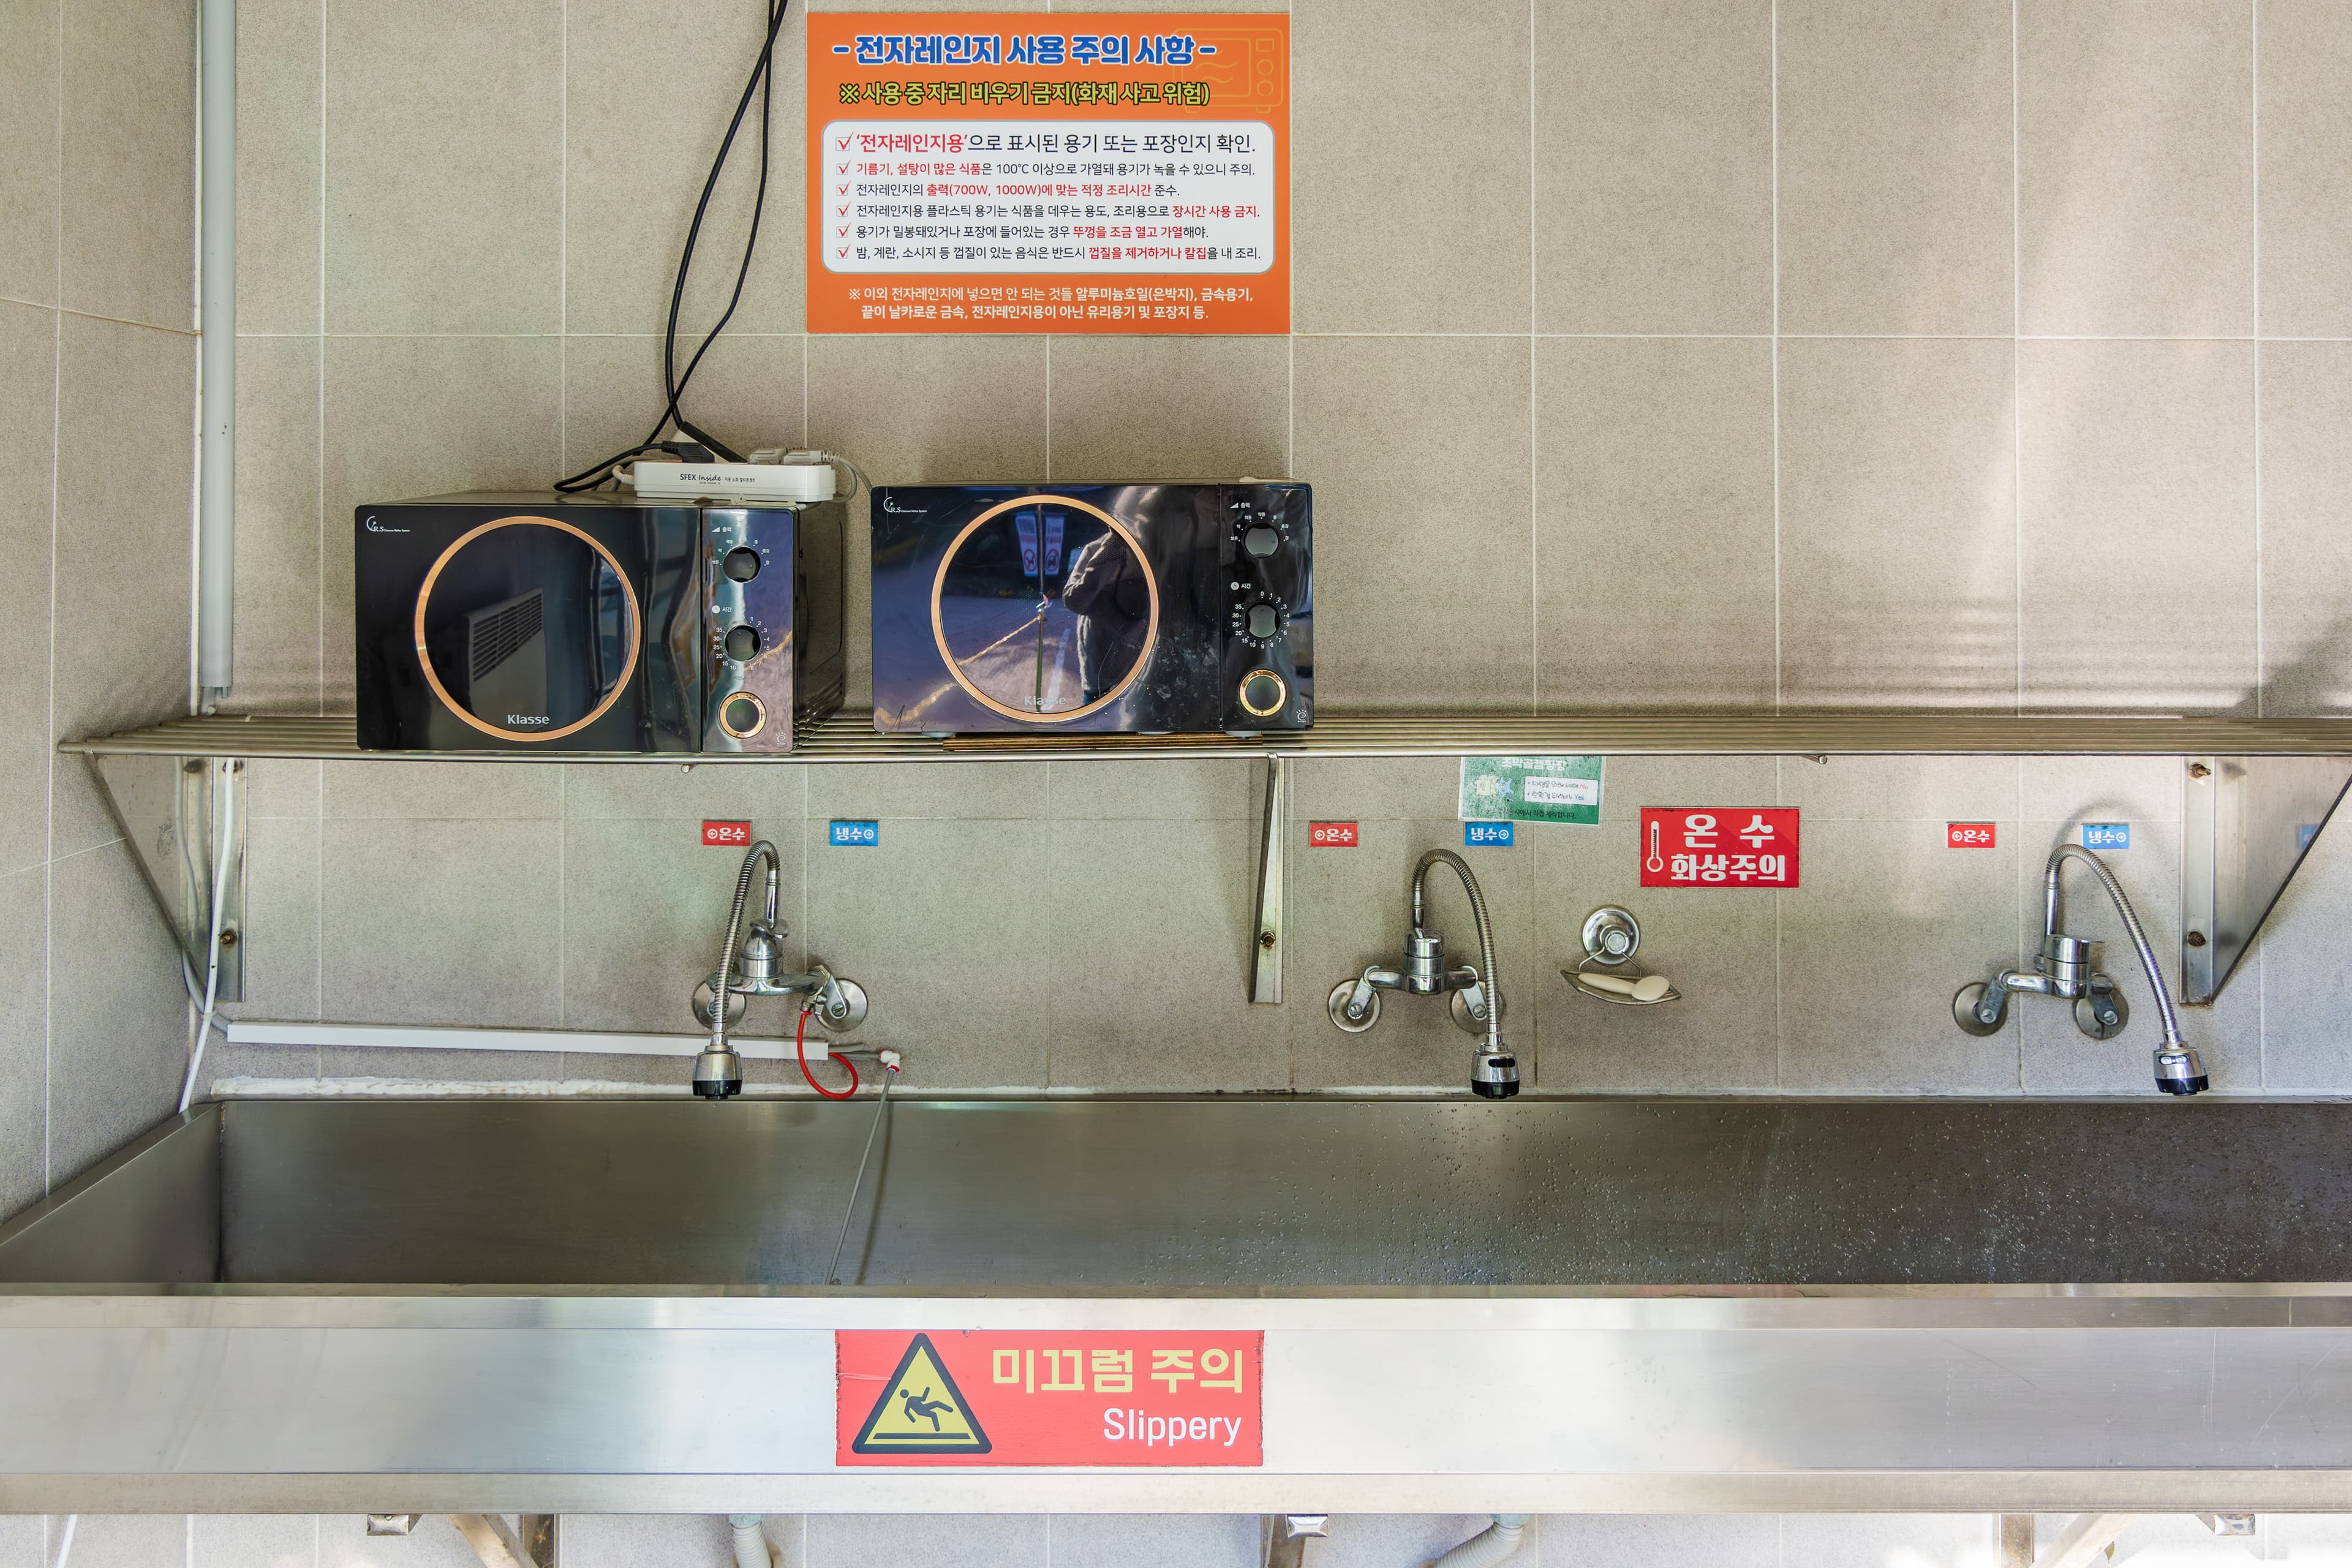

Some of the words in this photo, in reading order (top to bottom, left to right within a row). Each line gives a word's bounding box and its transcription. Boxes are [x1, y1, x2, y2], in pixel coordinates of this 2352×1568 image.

[855, 34, 1001, 65] 전자레인지
[1005, 34, 1066, 65] 사용
[1070, 35, 1129, 65] 주의
[1134, 35, 1196, 66] 사항
[861, 81, 903, 106] 사용
[904, 81, 925, 106] 중
[925, 81, 968, 105] 자리
[969, 81, 1030, 105] 비우기
[1030, 81, 1118, 107] 금지(화재
[1119, 81, 1161, 106] 사고
[1161, 81, 1211, 107] 위험)
[1006, 134, 1058, 153] 표시된
[1063, 134, 1097, 154] 용기
[1102, 134, 1138, 153] 또는
[1142, 134, 1211, 154] 포장인지
[1216, 134, 1256, 154] 확인.
[857, 162, 893, 176] 기름기,
[897, 162, 930, 176] 설탕이
[933, 162, 956, 176] 많은
[959, 162, 993, 176] 식품은
[1032, 162, 1078, 176] 이상으로
[1080, 162, 1114, 176] 가열돼
[1117, 163, 1151, 176] 용기가
[1153, 163, 1177, 176] 녹을
[1178, 163, 1191, 176] 수
[1193, 163, 1226, 176] 있으니
[1229, 163, 1255, 176] 주의.
[856, 183, 923, 197] 전자레인지의
[926, 183, 991, 197] 출력(700W,
[995, 184, 1053, 197] 1000W)에
[1055, 184, 1079, 197] 맞는
[1081, 184, 1103, 197] 적정
[1106, 184, 1152, 197] 조리시간
[1154, 184, 1180, 197] 준수.
[856, 204, 924, 218] 전자레인지용
[926, 204, 971, 217] 플라스틱
[974, 204, 1009, 218] 용기는
[1011, 204, 1045, 218] 식품을
[1047, 204, 1082, 218] 데우는
[1084, 205, 1110, 218] 용도,
[1113, 205, 1170, 218] 조리용으로
[1172, 205, 1207, 218] 장시간
[1208, 205, 1232, 219] 사용
[1234, 205, 1260, 218] 금지.
[856, 225, 891, 239] 용기가
[893, 225, 961, 239] 밀봉돼있거나
[962, 225, 997, 239] 포장에
[999, 225, 1046, 239] 들어있는
[1048, 225, 1071, 239] 경우
[1072, 225, 1107, 239] 뚜껑을
[1109, 226, 1133, 239] 조금
[1135, 225, 1158, 239] 열고
[1161, 225, 1208, 239] 가열해야.
[856, 246, 870, 260] 밤,
[873, 246, 899, 260] 계란,
[902, 246, 936, 260] 소시지
[938, 246, 951, 260] 등
[953, 246, 986, 260] 껍질이
[990, 246, 1012, 260] 있는
[1015, 246, 1049, 260] 음식은
[1052, 246, 1085, 260] 반드시
[1088, 246, 1123, 260] 껍질을
[1125, 246, 1182, 260] 제거하거나
[1184, 247, 1219, 260] 칼집을
[1221, 246, 1232, 260] 내
[1235, 246, 1261, 260] 조리.
[864, 287, 888, 301] 이외
[891, 287, 963, 301] 전자레인지에
[967, 287, 1003, 301] 넣으면
[1006, 287, 1019, 301] 안
[1021, 287, 1046, 301] 되는
[1049, 287, 1073, 301] 것들
[1076, 287, 1197, 302] 알루미늄호일(은박지),
[1200, 287, 1253, 302] 금속용기,
[861, 304, 886, 319] 끝이
[889, 304, 938, 319] 날카로운
[940, 305, 968, 319] 금속,
[972, 304, 1056, 319] 전자레인지용이
[1059, 305, 1084, 319] 아닌
[1087, 305, 1135, 320] 유리용기
[1139, 305, 1150, 319] 및
[1153, 305, 1189, 320] 포장지
[1193, 306, 1208, 320] 등.
[507, 714, 549, 725] Klasse
[718, 827, 745, 840] 온수
[835, 827, 863, 840] 냉수
[1326, 828, 1353, 842] 온수
[1471, 827, 1498, 841] 냉수
[1963, 830, 1990, 843] 온수
[2088, 831, 2115, 844] 냉수
[1670, 853, 1785, 881] 화상주의
[992, 1349, 1134, 1393] 미끄럼
[1150, 1348, 1243, 1393] 주의
[1103, 1408, 1242, 1447] Slippery
